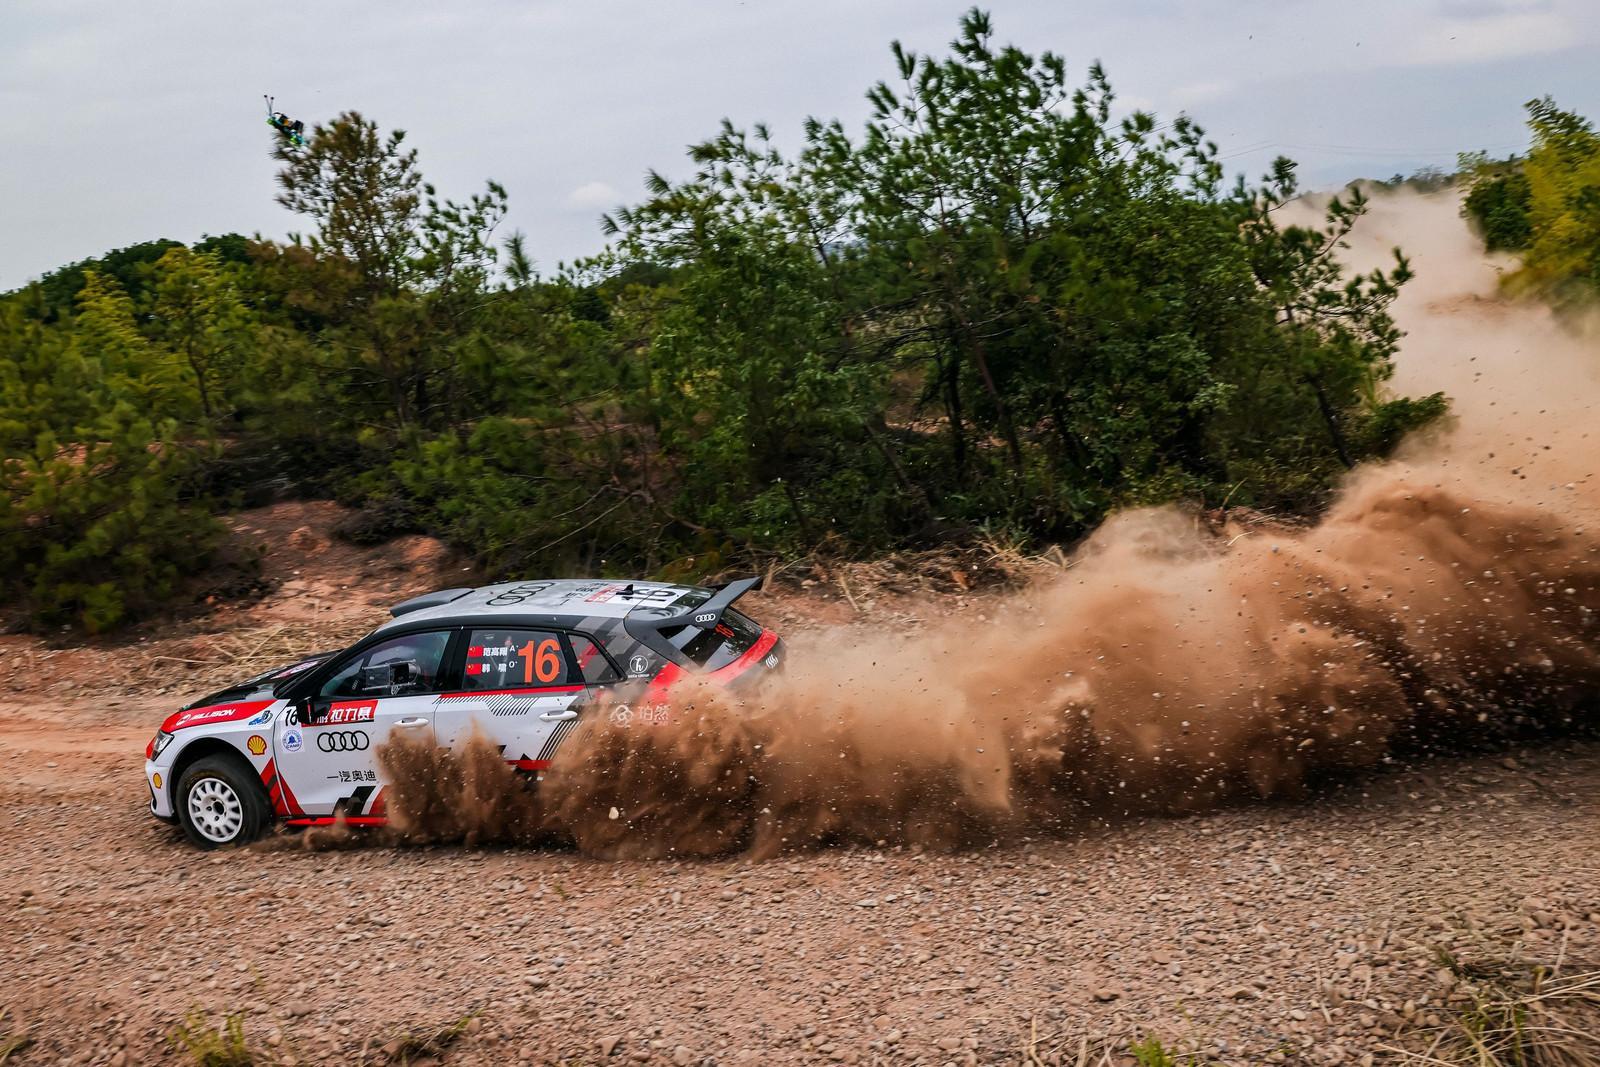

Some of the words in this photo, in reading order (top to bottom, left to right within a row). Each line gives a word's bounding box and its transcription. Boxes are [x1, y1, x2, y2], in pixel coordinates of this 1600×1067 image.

[517, 638, 560, 683] 16
[285, 708, 298, 726] 16
[327, 770, 377, 782] 一汽奥迪
